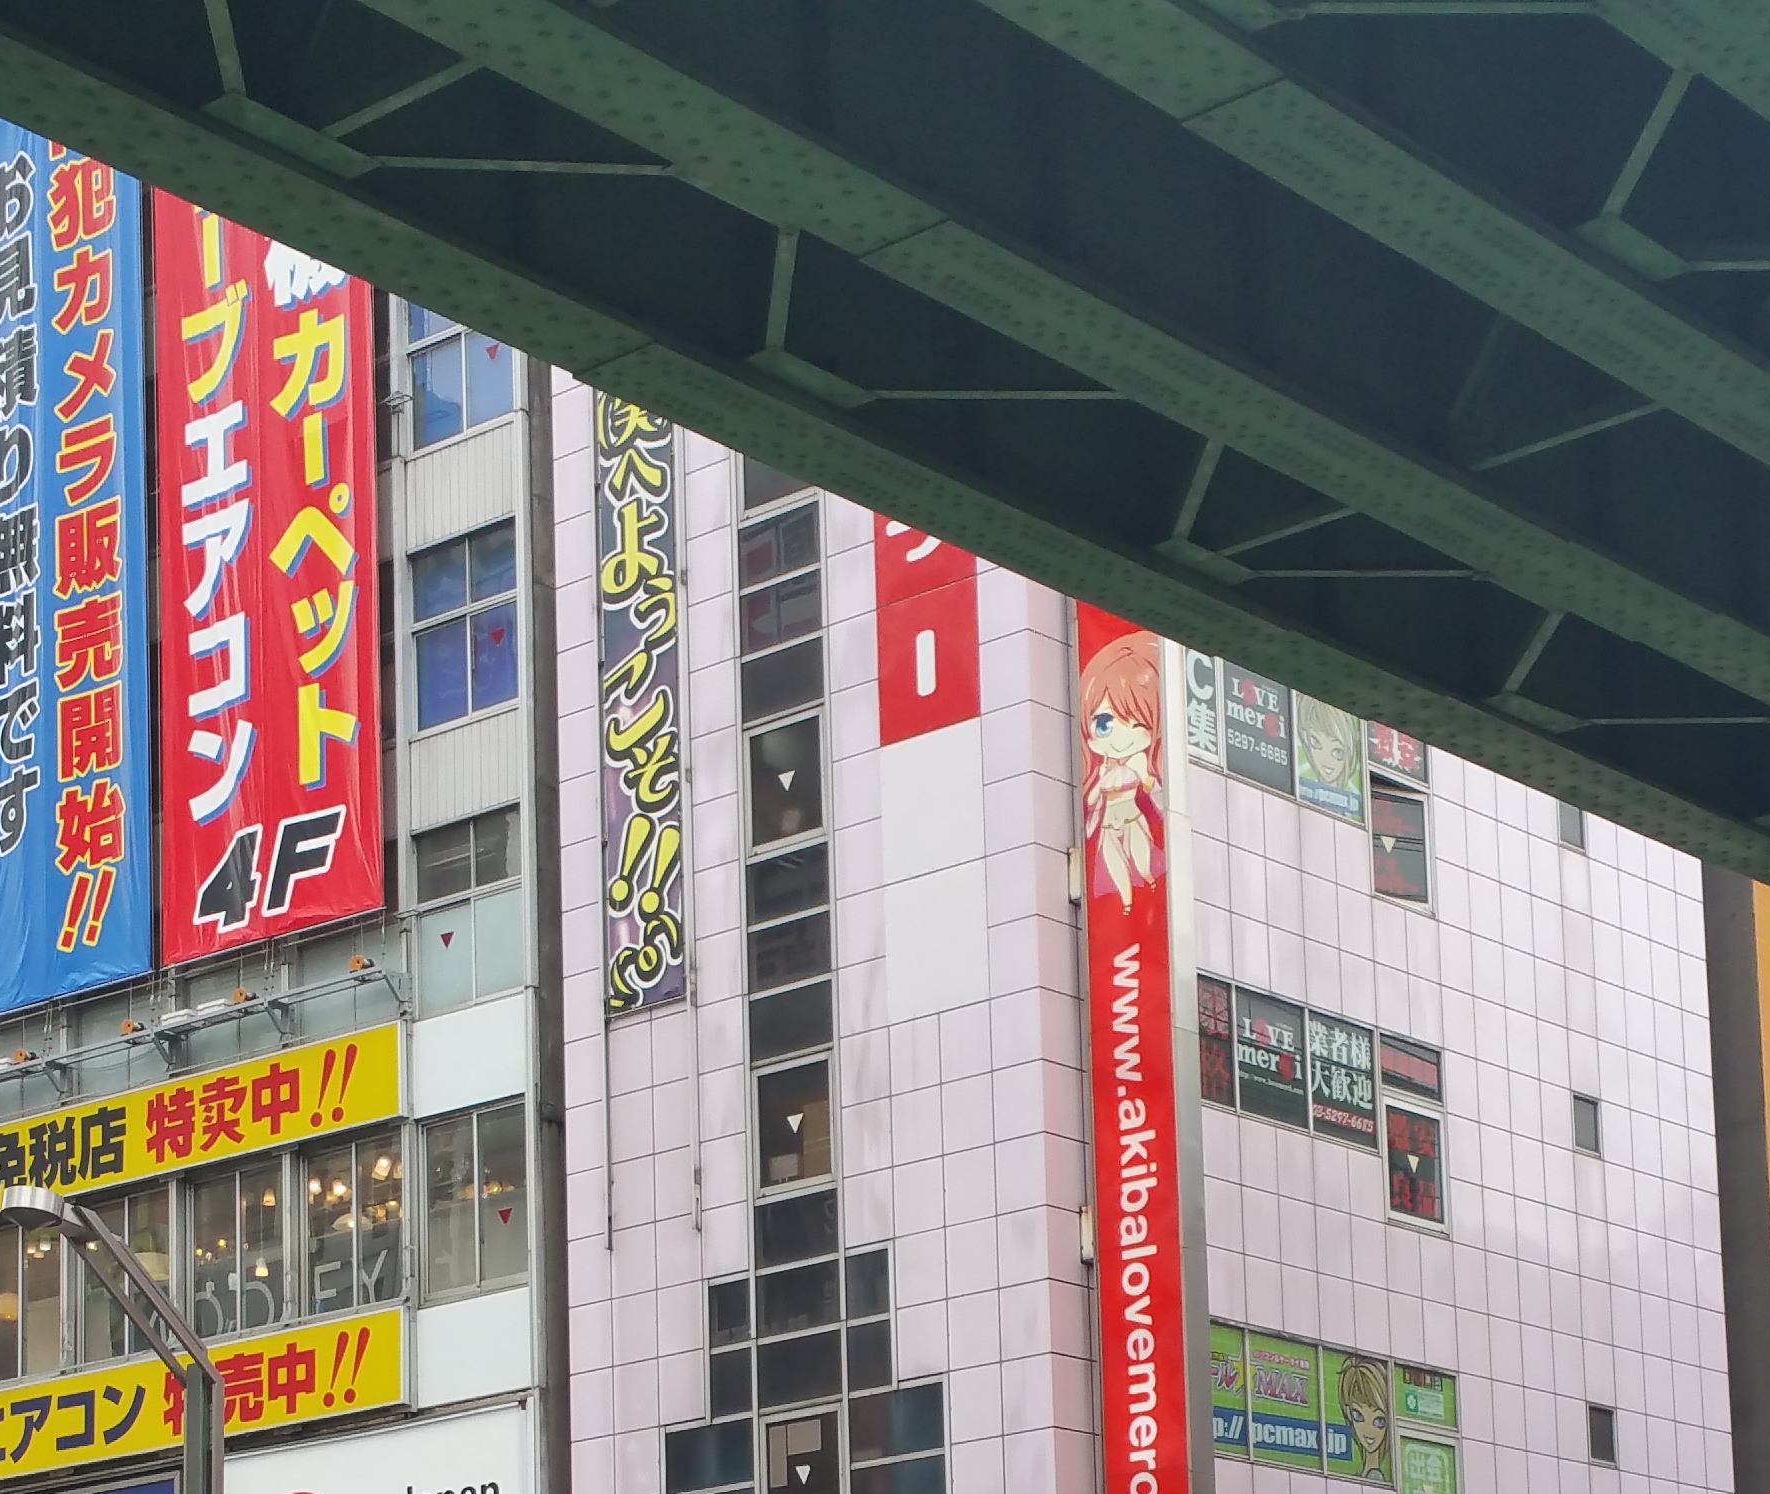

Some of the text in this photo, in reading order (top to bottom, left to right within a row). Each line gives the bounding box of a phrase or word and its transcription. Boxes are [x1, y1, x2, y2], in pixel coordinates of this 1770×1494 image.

[1231, 675, 1280, 714] LOVE
[1187, 698, 1219, 755] 集
[194, 804, 347, 933] 4F
[1242, 1015, 1296, 1053] LOVE
[1309, 1019, 1372, 1071] 業者様
[1311, 1059, 1374, 1111] 大歓迎
[1255, 1368, 1310, 1407] MAX
